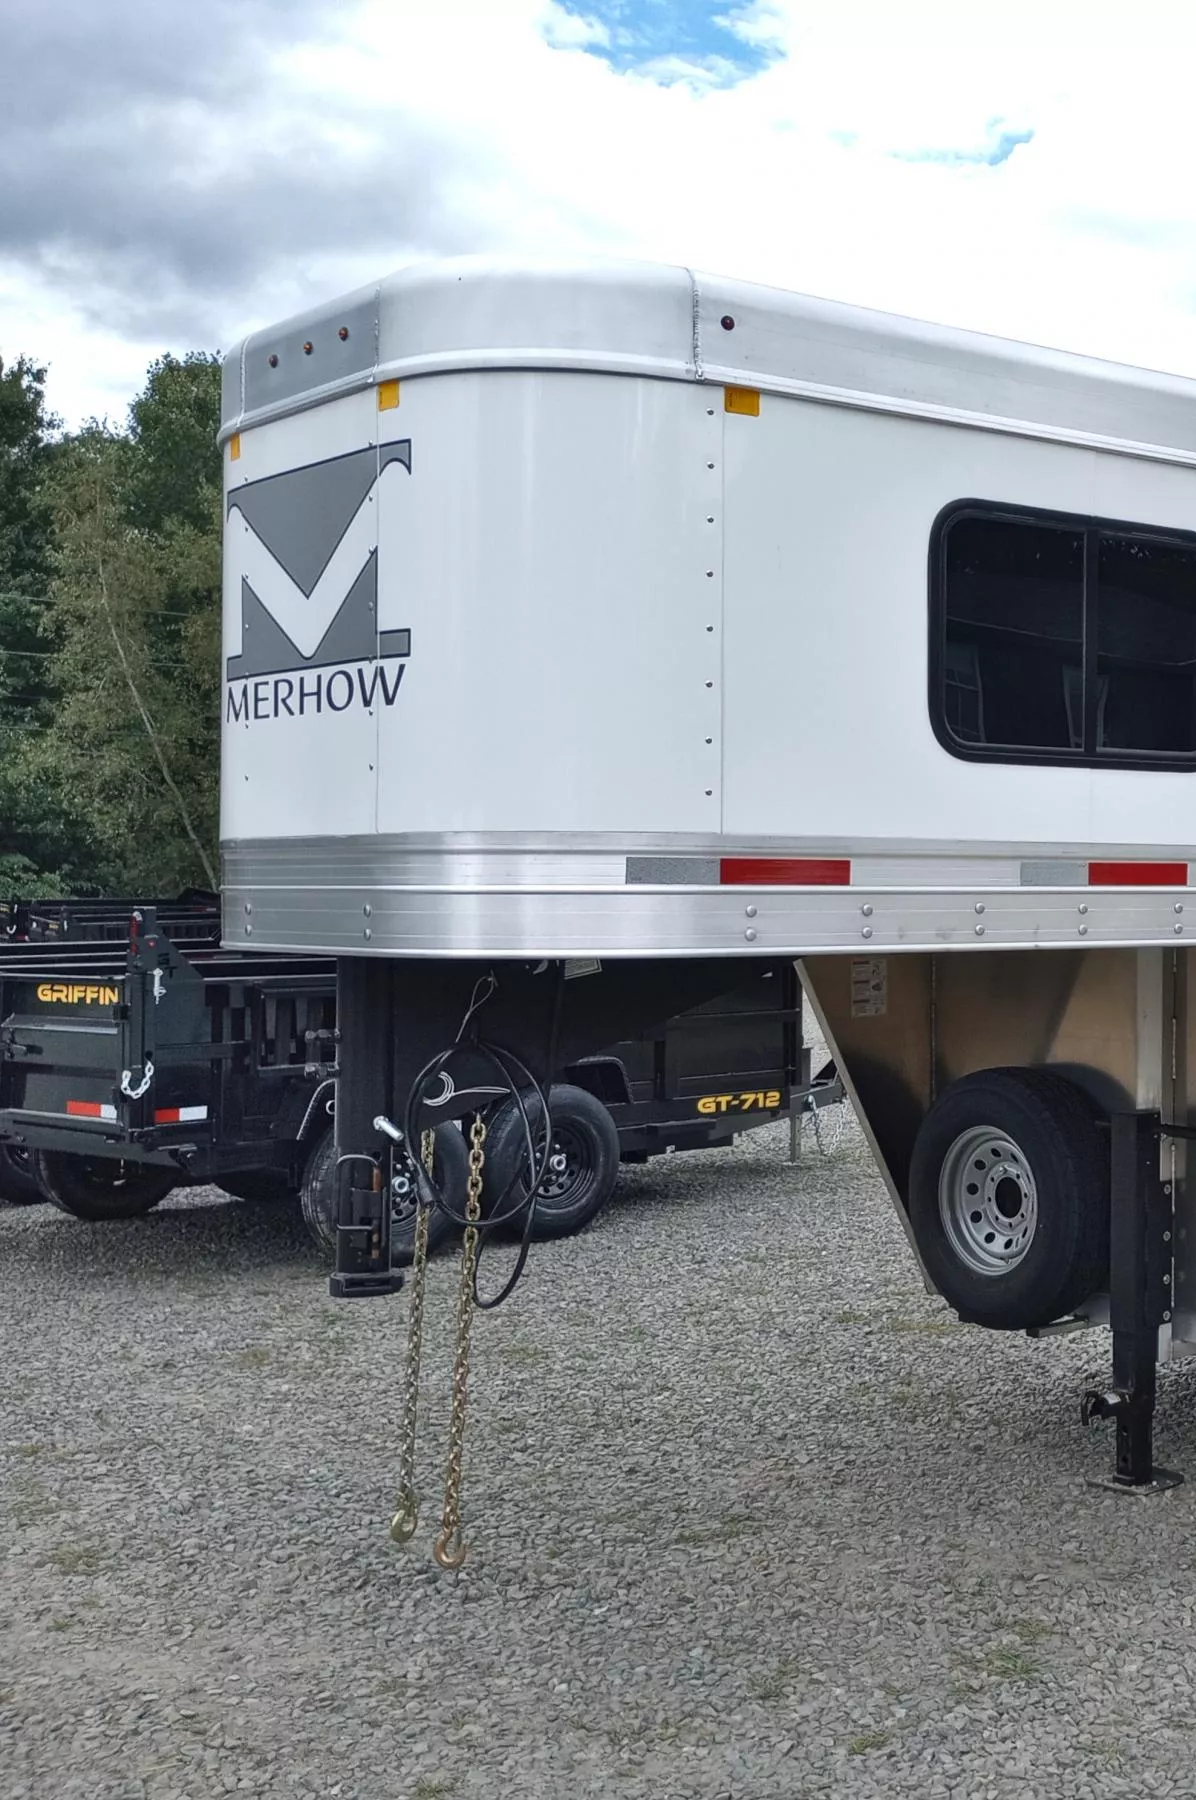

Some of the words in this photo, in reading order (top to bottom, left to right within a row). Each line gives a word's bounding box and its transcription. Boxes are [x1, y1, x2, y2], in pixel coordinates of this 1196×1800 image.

[226, 663, 406, 724] MERHOW
[36, 983, 119, 1006] GRIFFIN
[697, 1090, 781, 1114] GT-712
